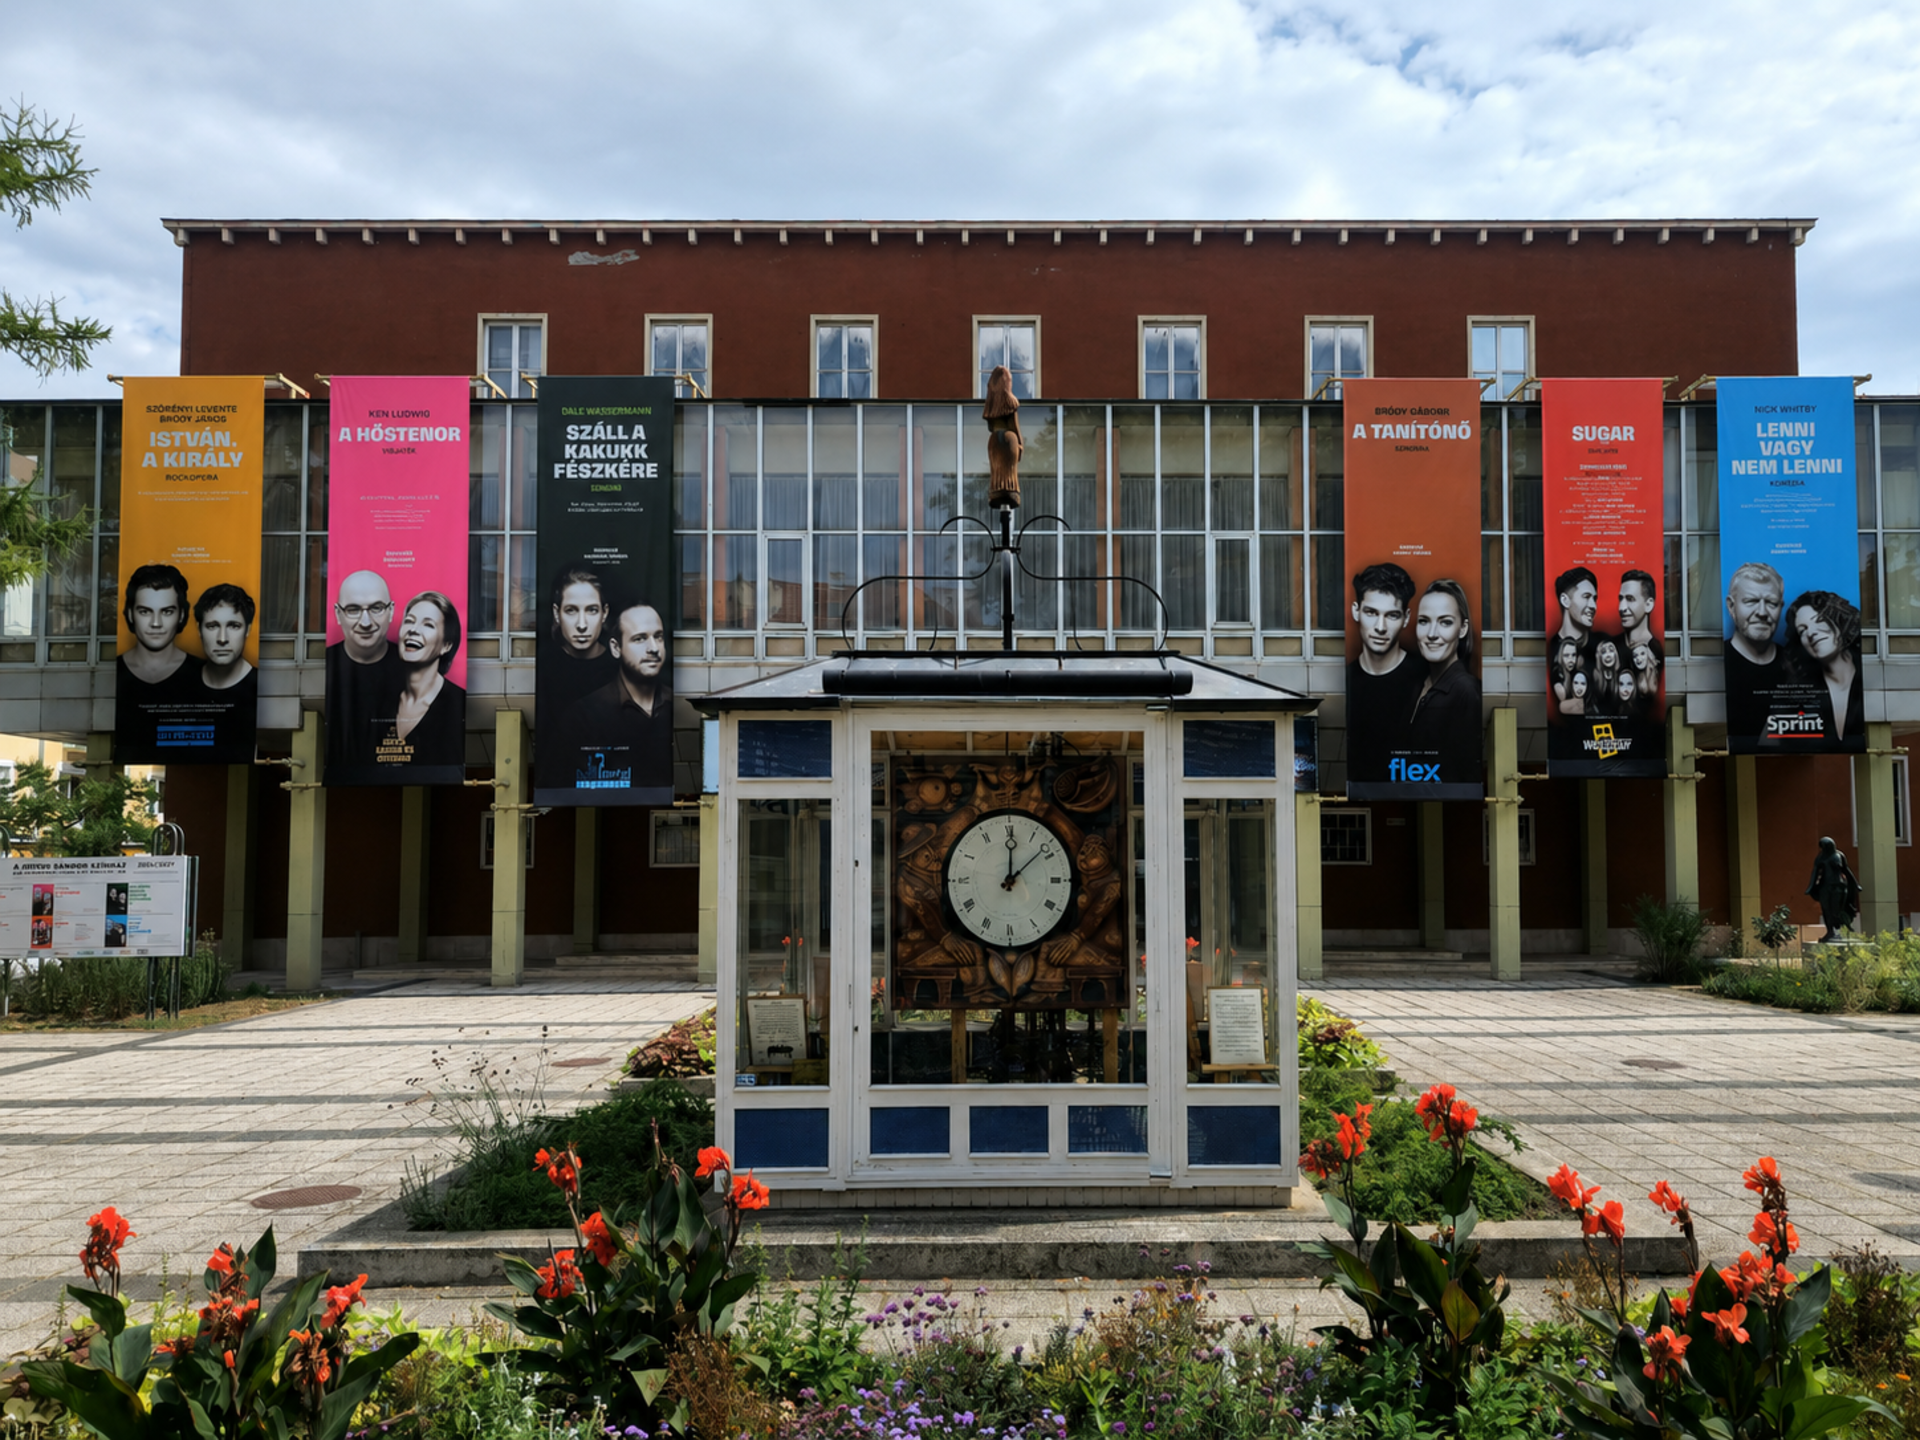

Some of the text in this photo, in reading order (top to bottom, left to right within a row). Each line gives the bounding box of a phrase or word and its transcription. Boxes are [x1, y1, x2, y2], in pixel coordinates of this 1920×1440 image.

[368, 410, 430, 418] KEN LUDWIG
[562, 407, 585, 416] DALE
[1755, 405, 1817, 414] NICK WHITBY
[338, 423, 461, 442] A HŐSTENOR
[566, 421, 646, 441] SZÁLL A
[1352, 420, 1472, 440] A TANÍTÓNŐ
[1572, 425, 1635, 441] SUGAR
[1756, 422, 1815, 438] LENNI
[564, 443, 648, 459] KAKUKK
[1759, 440, 1814, 456] VAGY
[141, 447, 244, 468] A KIRÁLY
[554, 459, 658, 479] FÉSZKÉRE
[1731, 458, 1842, 476] NEM LENNI
[1767, 713, 1824, 735] Sprint
[1388, 757, 1442, 782] flex
